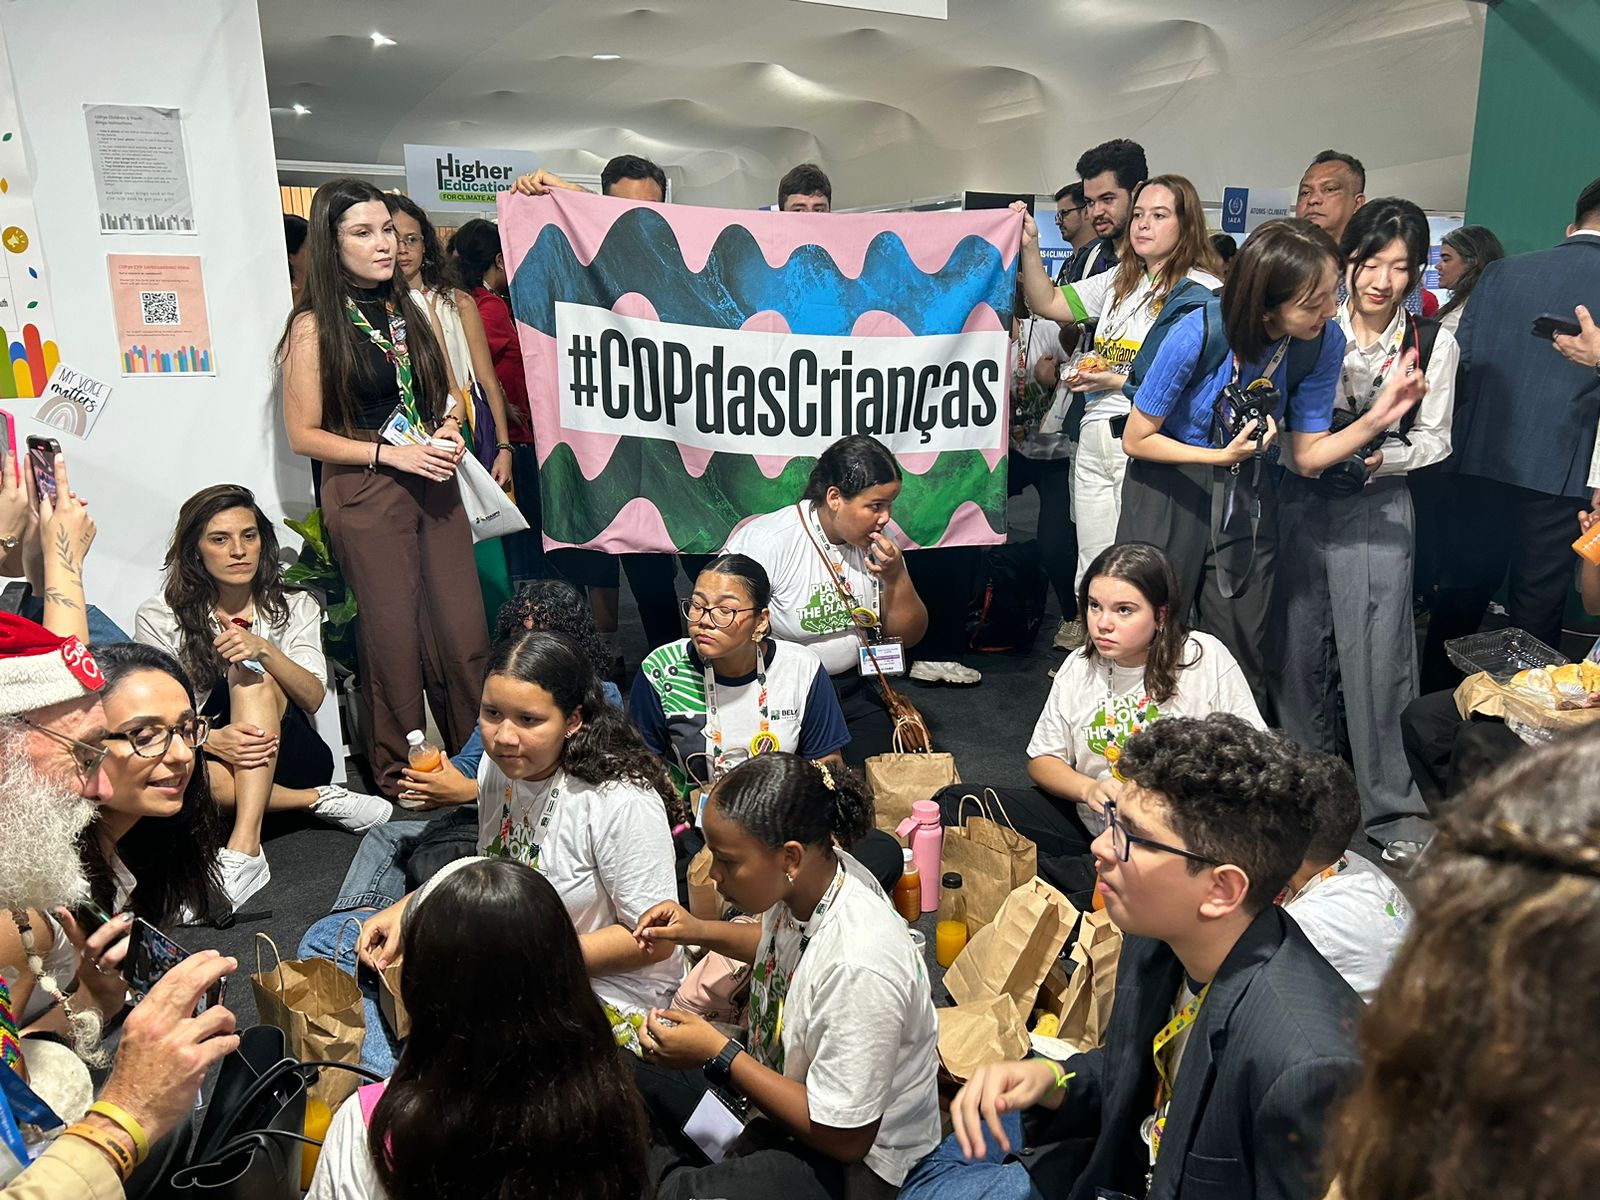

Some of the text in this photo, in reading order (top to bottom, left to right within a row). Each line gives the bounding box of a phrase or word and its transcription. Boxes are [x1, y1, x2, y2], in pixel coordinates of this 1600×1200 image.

[436, 153, 512, 190] Higher
[51, 382, 98, 413] matters
[58, 368, 104, 397] MY VOICE
[568, 328, 999, 443] #COPdasCrianças
[797, 606, 821, 620] THE
